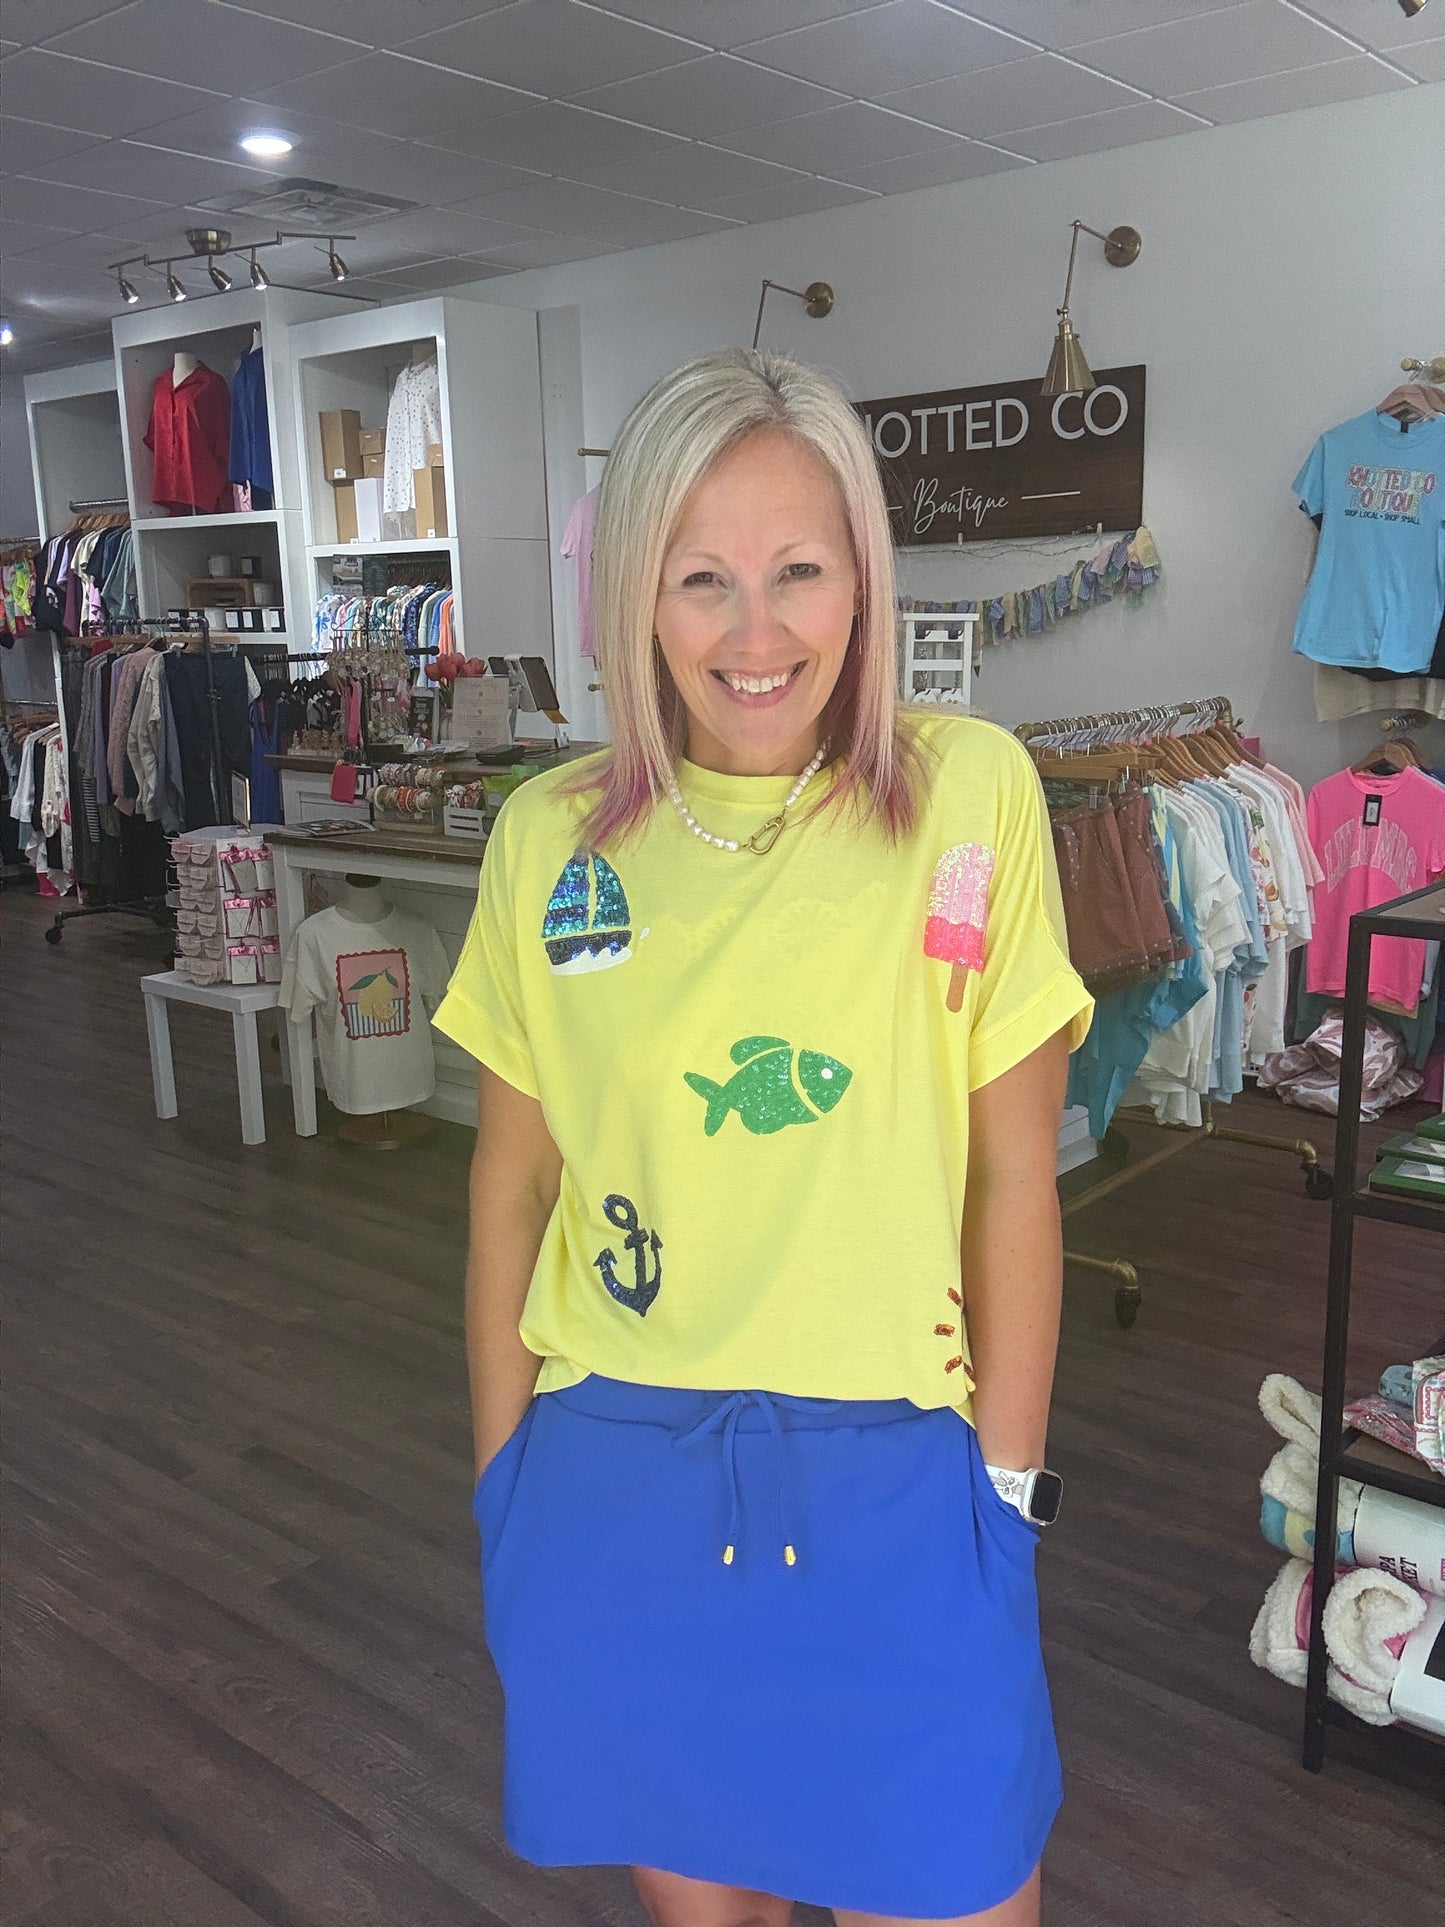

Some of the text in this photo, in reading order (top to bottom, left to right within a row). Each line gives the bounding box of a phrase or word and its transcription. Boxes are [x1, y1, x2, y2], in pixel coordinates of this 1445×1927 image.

[865, 384, 1129, 458] OTTED CO
[913, 477, 1009, 535] Boutique
[1360, 510, 1380, 520] LOCAL
[1401, 515, 1421, 526] SMALL
